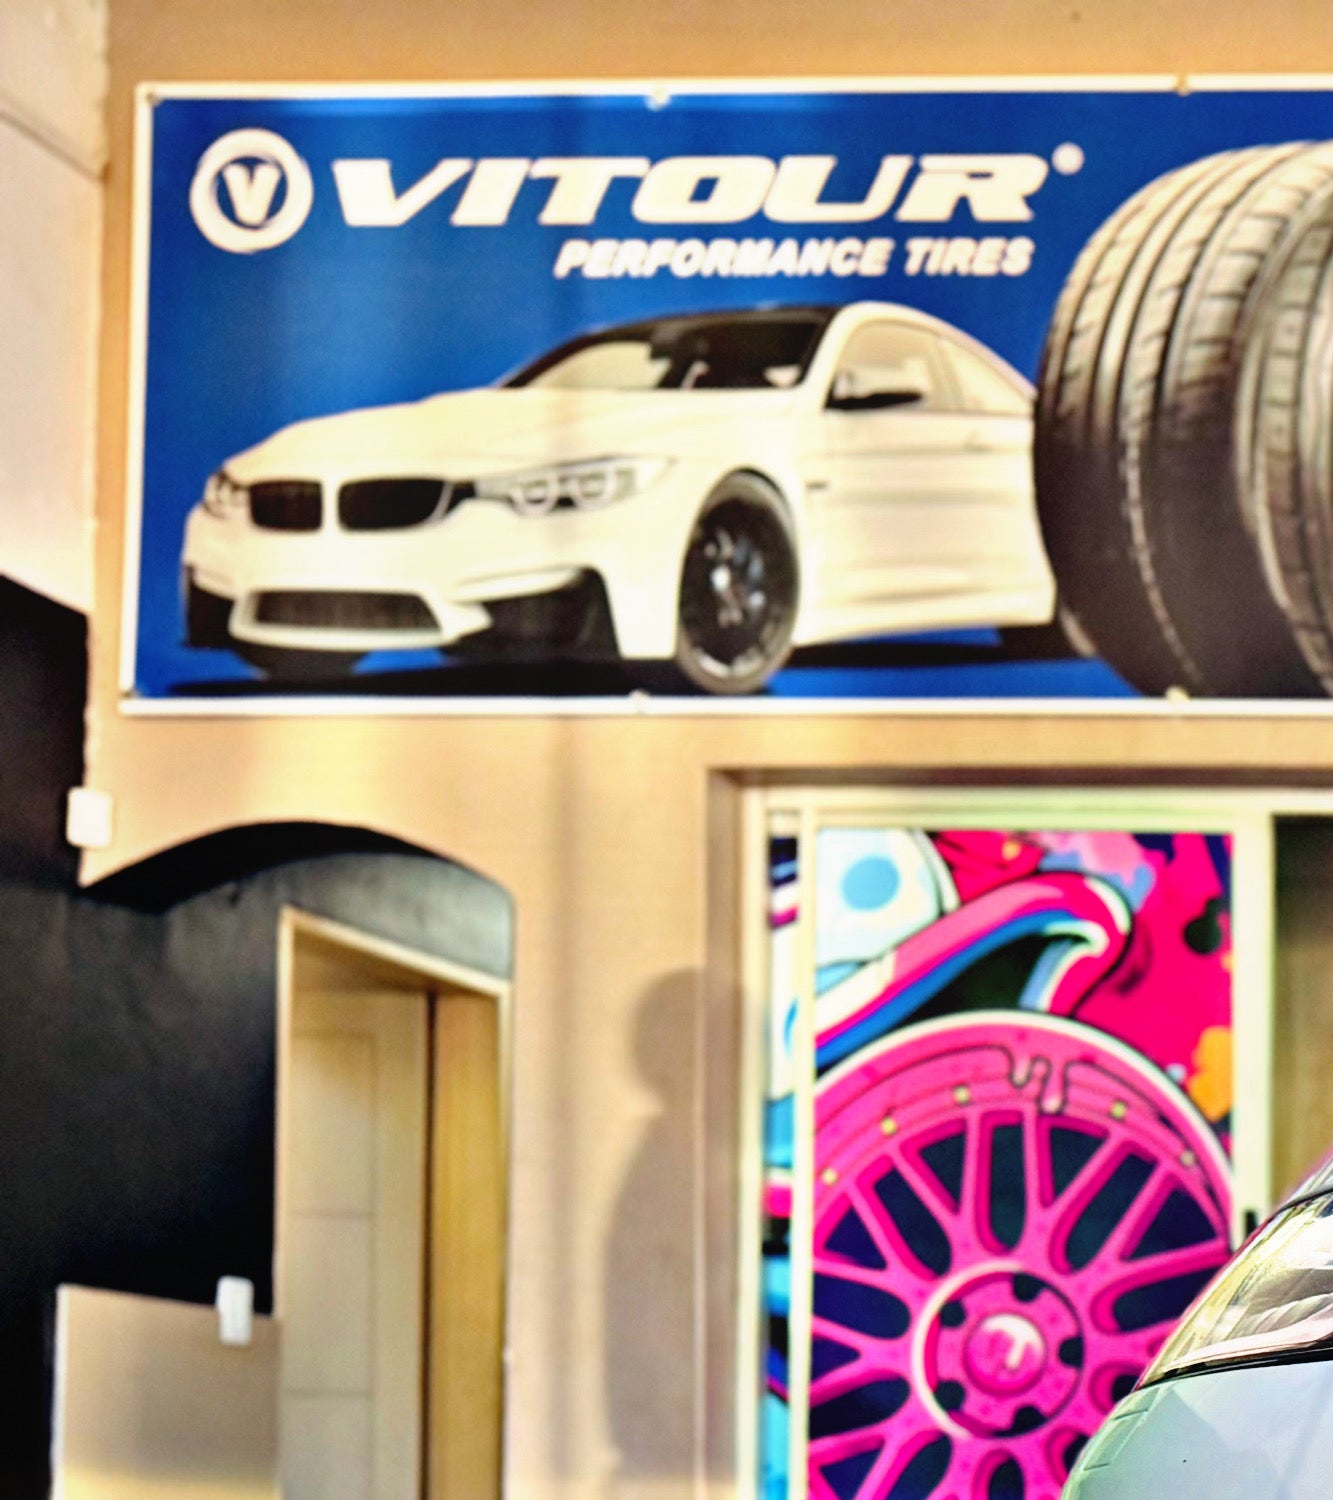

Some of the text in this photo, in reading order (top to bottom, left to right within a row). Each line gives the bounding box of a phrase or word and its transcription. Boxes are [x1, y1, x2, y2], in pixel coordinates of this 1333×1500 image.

[331, 153, 1050, 227] VITOUR
[553, 236, 1036, 279] PERFORMANCE TIRES
